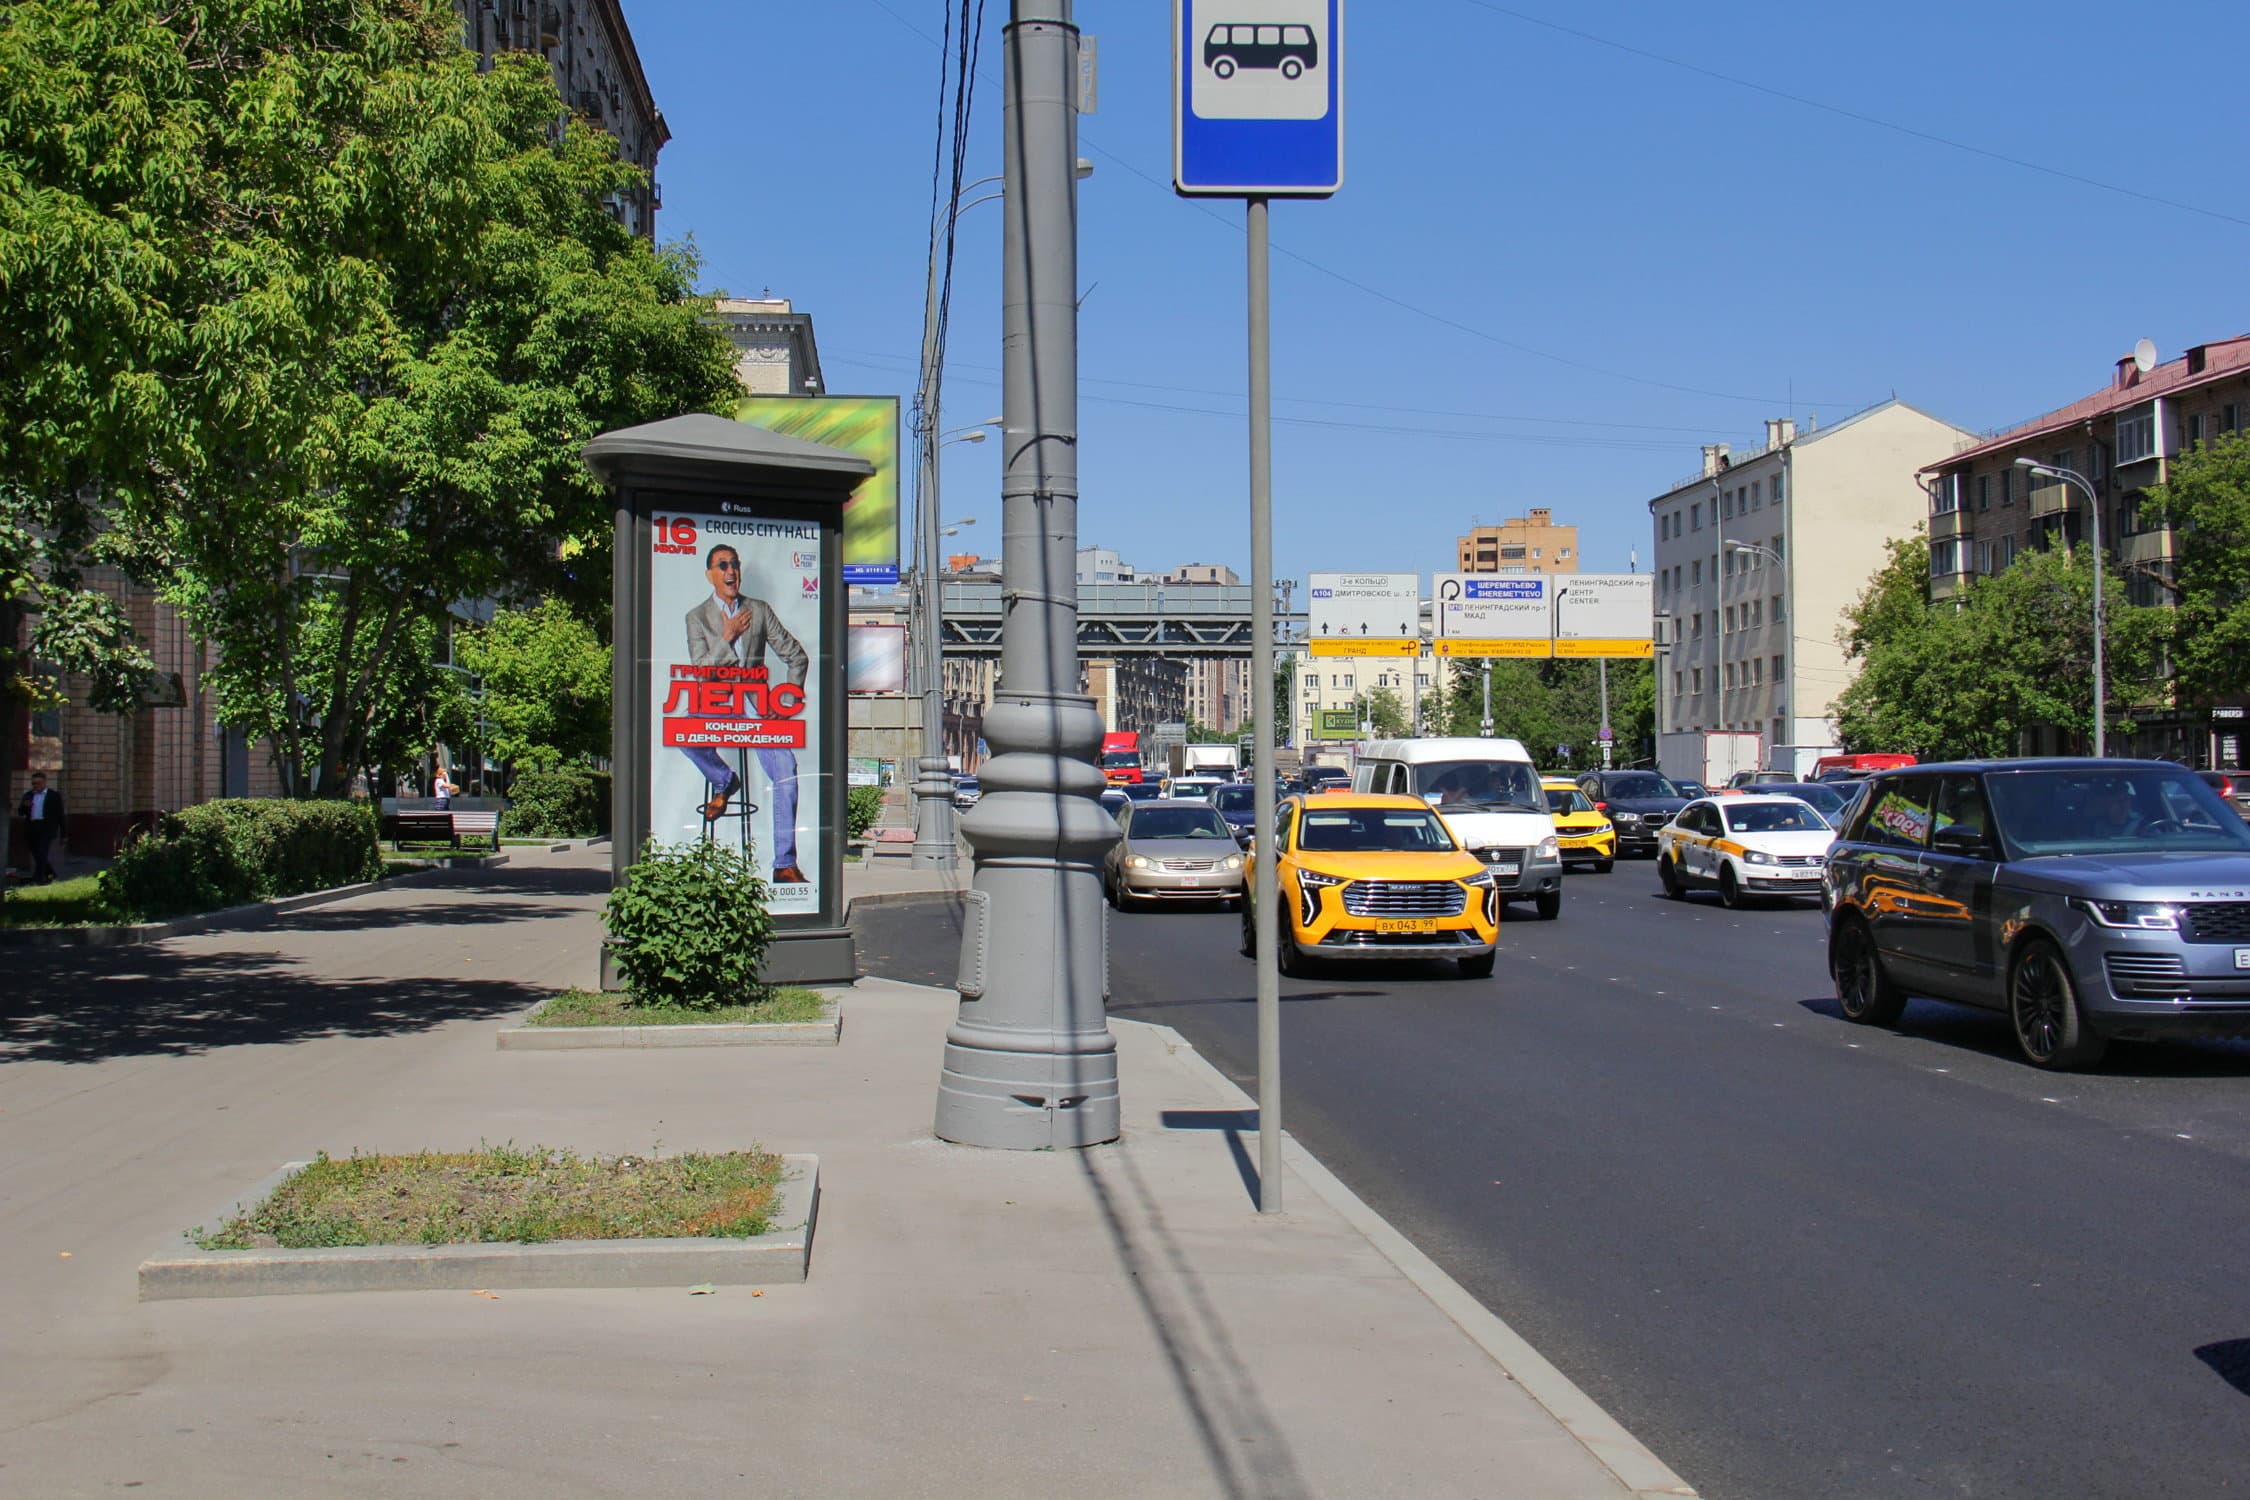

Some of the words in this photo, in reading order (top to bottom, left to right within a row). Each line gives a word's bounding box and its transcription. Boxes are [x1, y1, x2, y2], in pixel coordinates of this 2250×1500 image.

[654, 516, 697, 545] 16
[705, 519, 754, 536] CROCUS
[757, 523, 782, 538] CITY
[784, 525, 818, 540] HALL
[653, 544, 697, 555] ИЮЛЯ
[1355, 578, 1387, 586] КОЛЬЦО
[1569, 579, 1634, 587] ЛЕНИНГРАДСКИЙ
[1334, 590, 1392, 598] ДМИТРОВСКОЕ
[1464, 603, 1530, 611] ЛЕНИНГРАДСКИЙ
[670, 664, 768, 680] ГРИГОРИЙ
[663, 680, 806, 717] ЛЕПС
[705, 722, 763, 732] КОНЦЕРТ
[675, 733, 685, 742] В
[688, 733, 721, 743] ДЕНЬ
[724, 733, 793, 744] РОЖДЕНИЯ
[780, 887, 796, 896] 000
[798, 887, 808, 896] 55
[1382, 922, 1395, 931] ВХ
[1397, 920, 1417, 930] 043
[1423, 919, 1434, 928] 99
